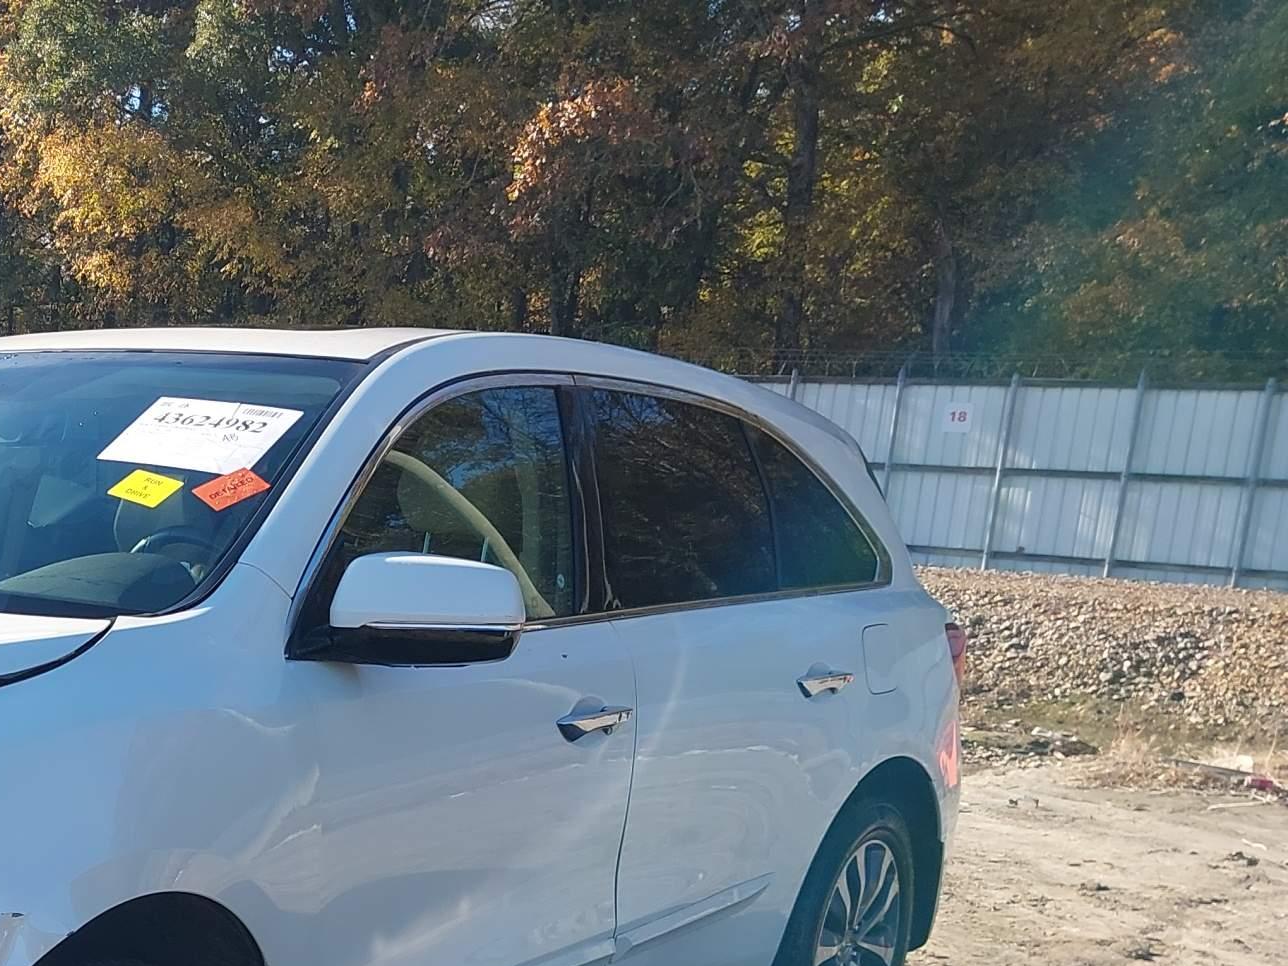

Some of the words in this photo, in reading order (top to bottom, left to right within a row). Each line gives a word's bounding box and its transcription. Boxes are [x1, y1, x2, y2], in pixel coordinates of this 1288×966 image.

[950, 411, 968, 423] 18
[153, 412, 268, 434] 43624982
[144, 477, 164, 487] RUN
[125, 488, 151, 499] DRIVE
